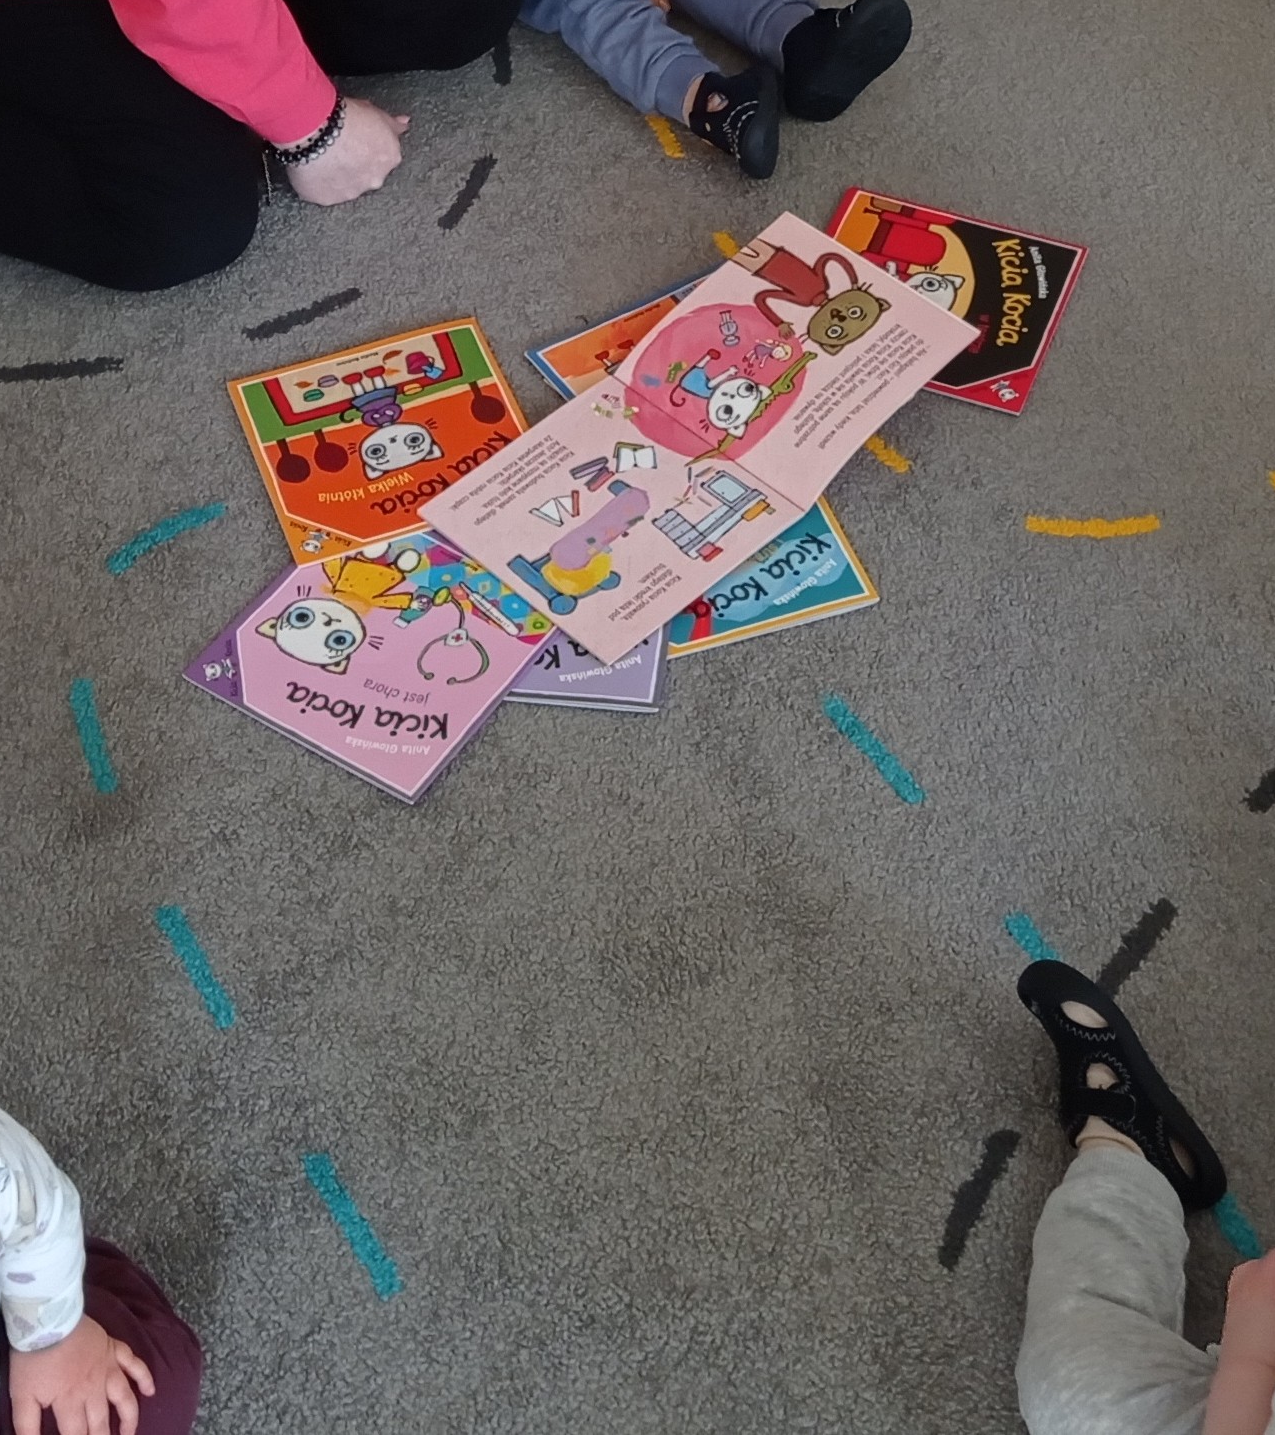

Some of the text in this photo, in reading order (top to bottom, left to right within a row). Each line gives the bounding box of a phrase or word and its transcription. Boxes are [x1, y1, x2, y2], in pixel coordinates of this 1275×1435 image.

[991, 239, 1032, 346] Kicia Kocia
[318, 472, 414, 503] Wielka kłótnia
[370, 473, 450, 516] Kocia
[760, 531, 832, 580] Kicia
[813, 558, 838, 578] Anita
[687, 576, 769, 618] Kocia
[559, 654, 642, 683] Anita Głowińska
[363, 678, 431, 705] jest chora
[286, 681, 449, 740] Kicia Kocia
[344, 735, 431, 756] Anita Głowińska
